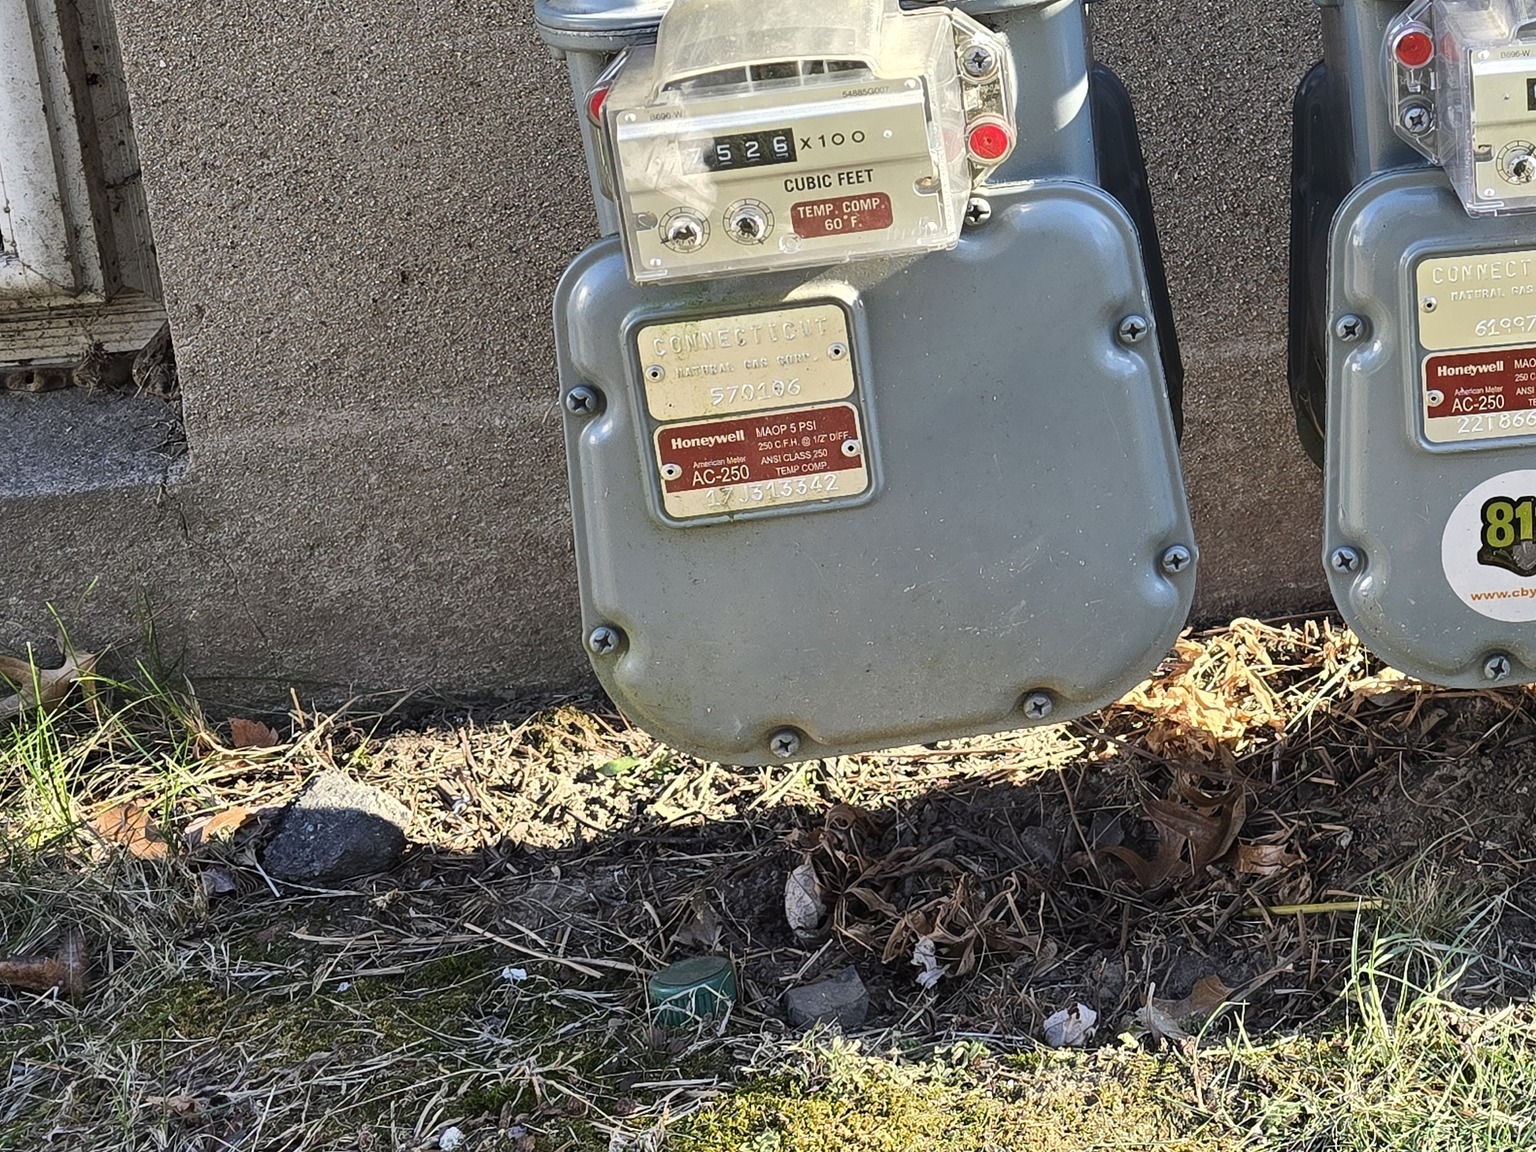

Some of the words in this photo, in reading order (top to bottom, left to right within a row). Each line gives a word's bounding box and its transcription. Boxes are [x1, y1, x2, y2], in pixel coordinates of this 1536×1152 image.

[784, 174, 832, 192] CUBIC
[839, 169, 874, 186] FEET
[843, 199, 885, 212] COMP.
[1451, 289, 1505, 301] NATURAL
[1511, 285, 1533, 295] GAS
[653, 317, 827, 356] CONNECTICUT
[676, 363, 734, 379] NATURAL
[743, 358, 768, 369] GAS
[1438, 361, 1503, 376] Honeywell
[1515, 373, 1528, 381] 250
[710, 378, 801, 405] 570106
[1516, 386, 1534, 395] ANSI
[1452, 395, 1504, 412] AC-250
[755, 425, 787, 437] MAOP
[790, 423, 796, 432] 5
[799, 421, 816, 431] PSI
[671, 430, 745, 449] Honeywell
[758, 442, 772, 451] 250
[761, 455, 781, 465] ANSI
[783, 451, 811, 462] CLASS
[812, 449, 827, 458] 250
[692, 465, 749, 486] AC-250
[776, 465, 799, 475] TEMP
